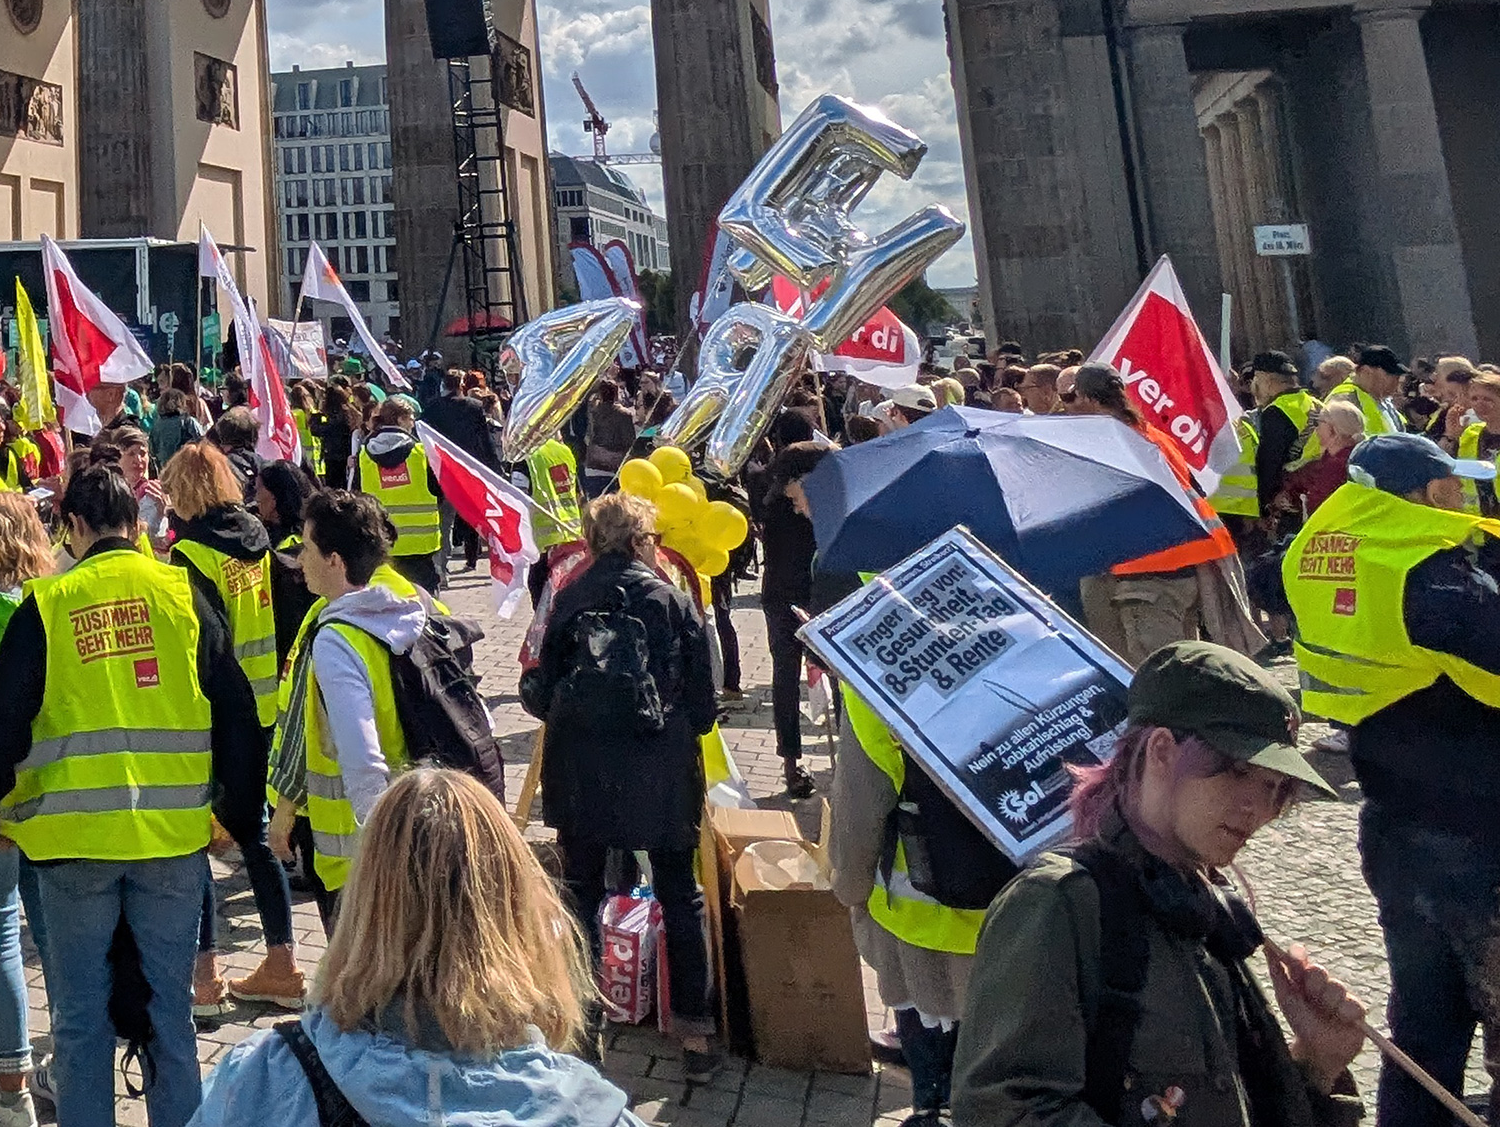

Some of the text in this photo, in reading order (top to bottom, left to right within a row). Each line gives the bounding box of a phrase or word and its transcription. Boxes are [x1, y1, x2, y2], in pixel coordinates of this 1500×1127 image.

[1120, 357, 1208, 454] ver.di
[70, 603, 150, 636] ZUSAMMEN
[76, 625, 154, 657] GEHT MEHR
[852, 607, 904, 656] Finger
[931, 564, 968, 593] von:
[875, 585, 985, 666] Gesundheit,
[885, 596, 1016, 695] 8-Stunden-Tag
[929, 629, 1008, 691] & Rente
[967, 684, 1106, 775] Nein zu allen Kürzungen,
[1002, 706, 1095, 771] Jobkahlschlag &
[1023, 723, 1094, 774] Aufrüstung!
